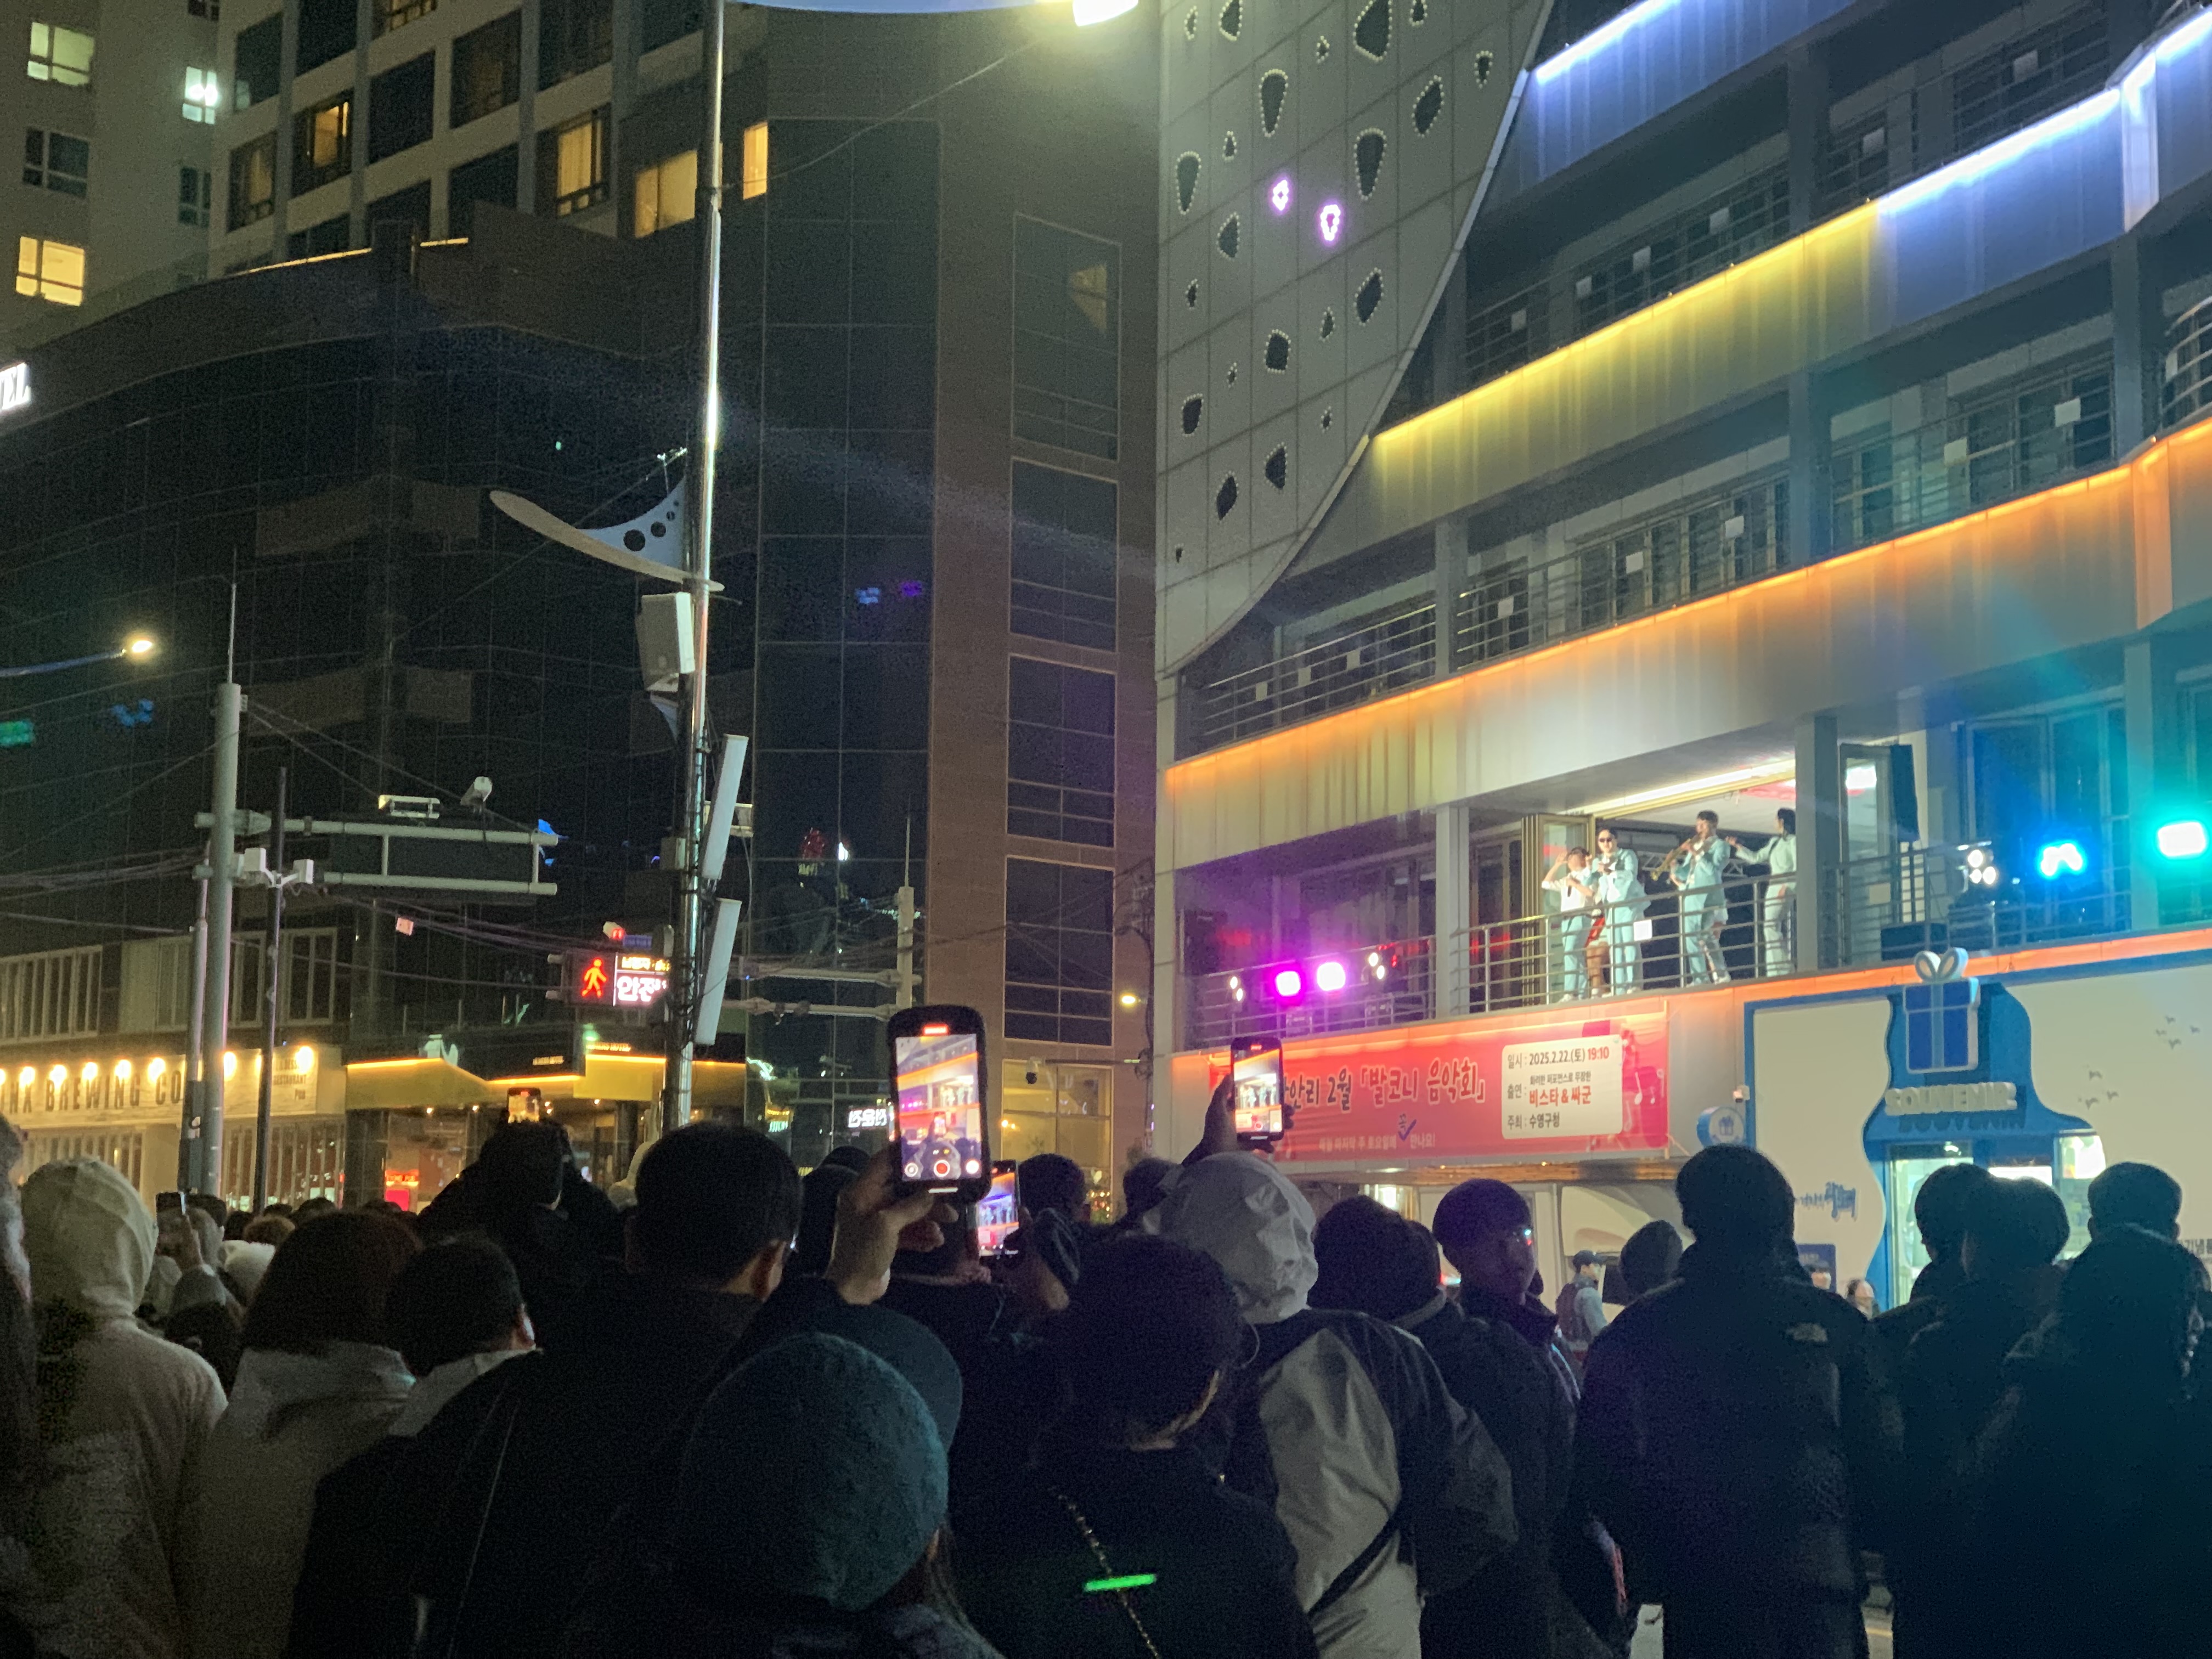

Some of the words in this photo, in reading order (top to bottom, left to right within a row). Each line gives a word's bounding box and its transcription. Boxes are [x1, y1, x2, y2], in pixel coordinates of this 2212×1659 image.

[1508, 1054, 1522, 1069] 일시
[1588, 1046, 1610, 1060] 19:10
[1327, 1068, 1352, 1111] 2월
[1507, 1083, 1522, 1099] 출연
[1529, 1087, 1559, 1108] 비스타
[1561, 1088, 1569, 1104] &
[1884, 1081, 2018, 1116] SOUVENIR
[1508, 1115, 1522, 1130] 주최
[1529, 1112, 1560, 1130] 수영구청
